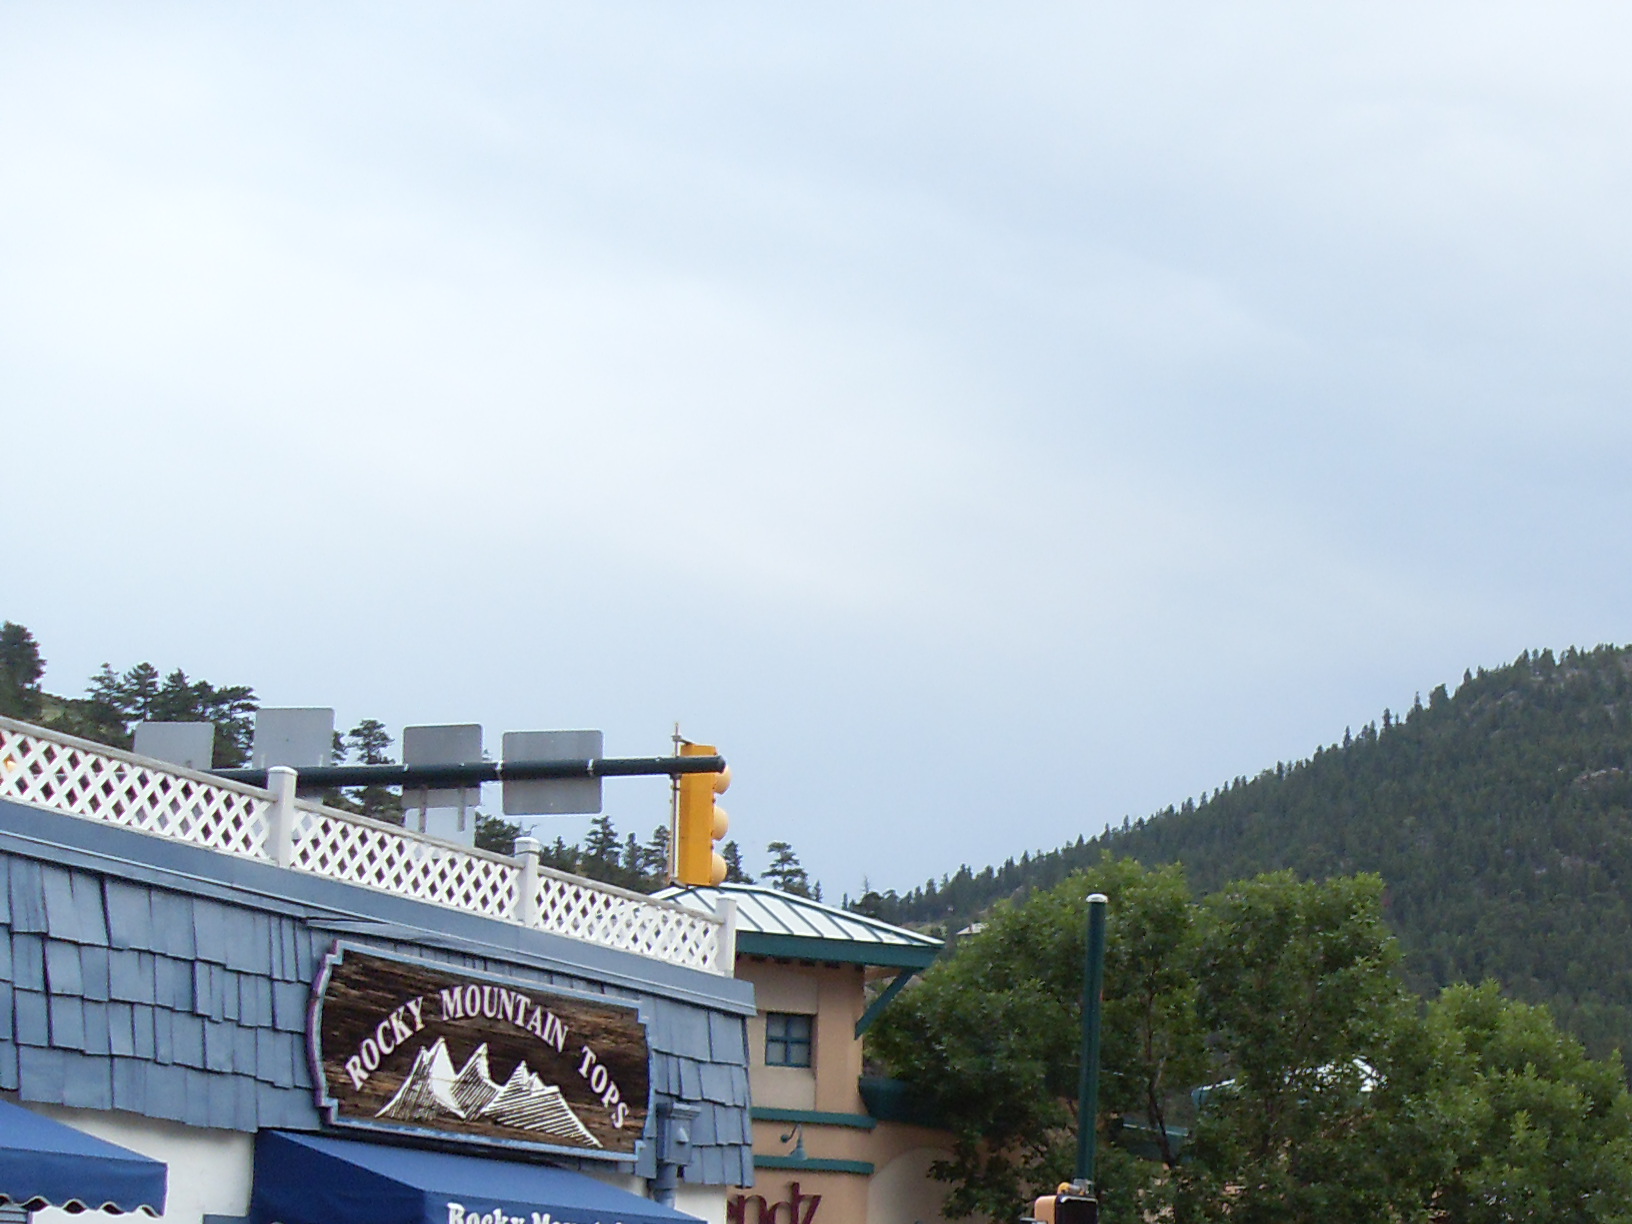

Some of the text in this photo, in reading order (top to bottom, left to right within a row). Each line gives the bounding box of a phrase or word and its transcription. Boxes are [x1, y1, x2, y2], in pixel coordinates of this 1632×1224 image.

[344, 984, 630, 1129] ROCKY MOUNTAIN TOPS
